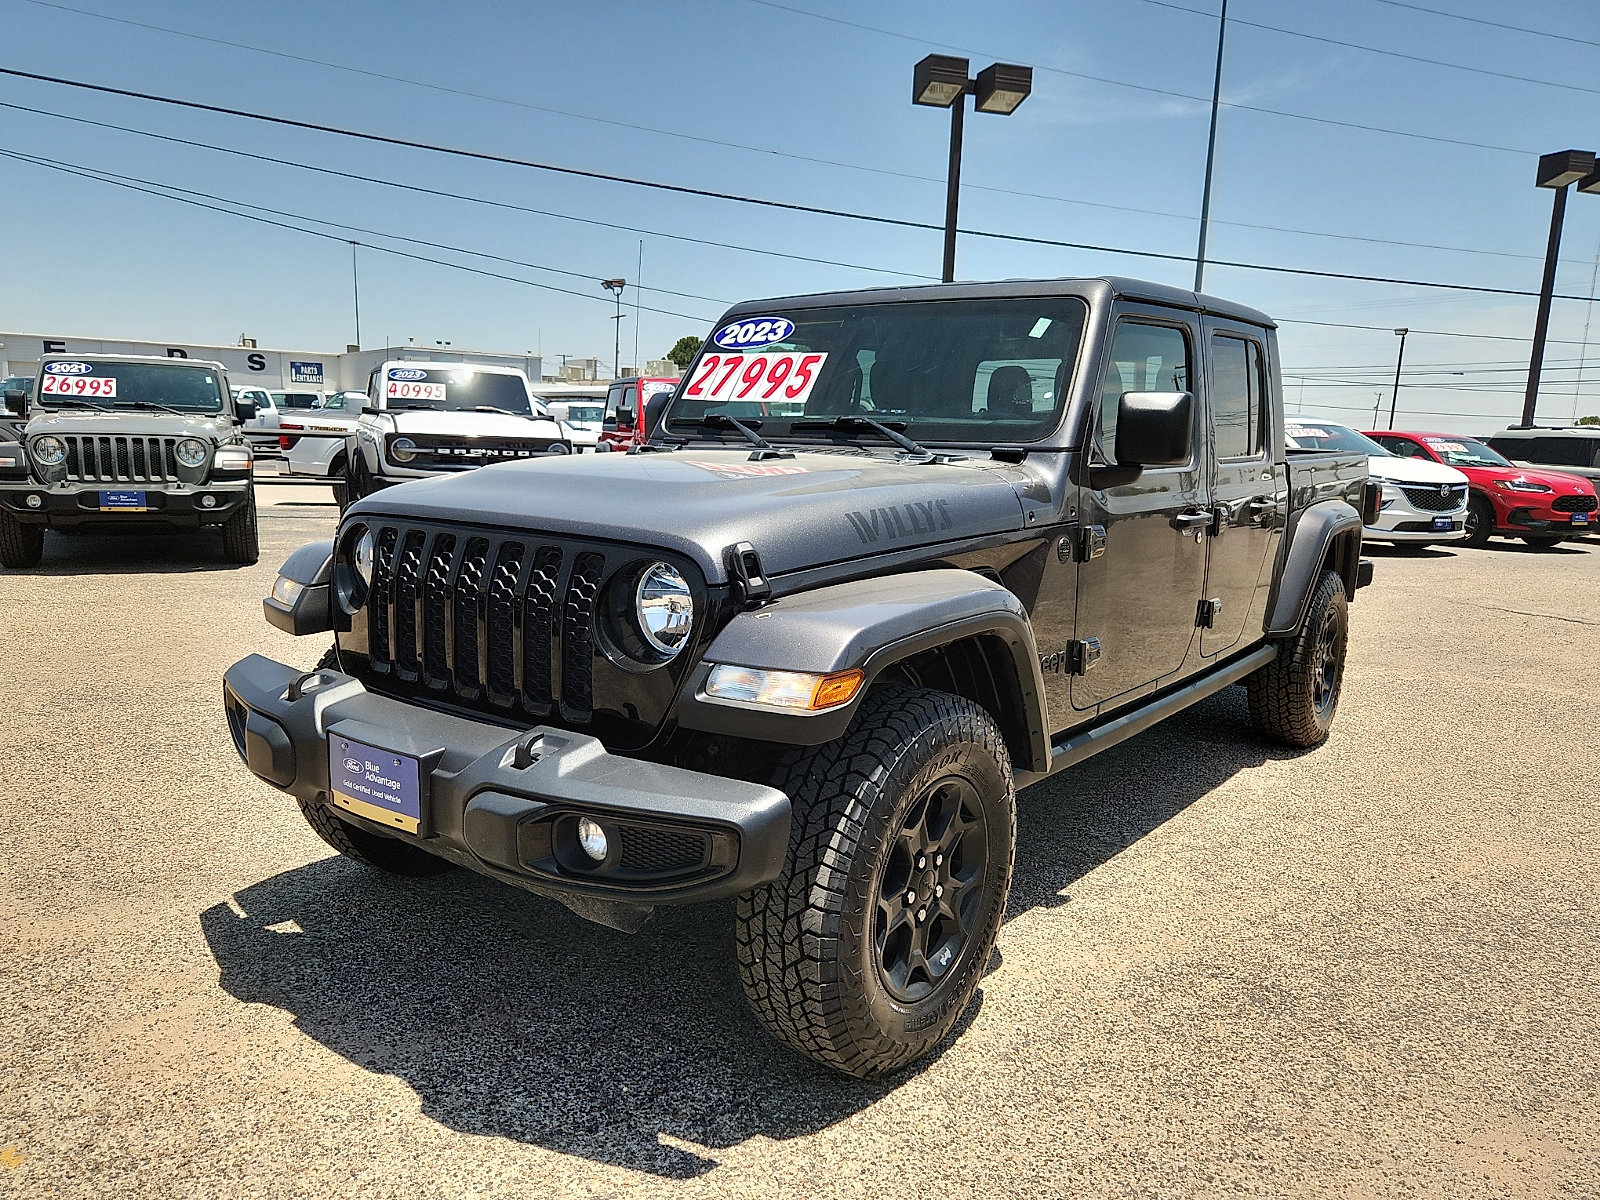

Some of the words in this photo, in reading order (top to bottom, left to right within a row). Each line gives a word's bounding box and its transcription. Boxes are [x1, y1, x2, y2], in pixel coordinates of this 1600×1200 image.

[719, 320, 789, 345] 2023
[51, 363, 86, 374] 2021
[301, 366, 318, 375] PARTS
[686, 354, 823, 399] 27995
[43, 375, 114, 396] 26995
[296, 373, 323, 383] ENTRANCE
[388, 382, 443, 398] 40995
[437, 448, 530, 457] BRONCO
[844, 499, 952, 544] WILLYS
[365, 760, 380, 773] Blue
[365, 771, 401, 790] Advantage
[343, 779, 353, 789] Gold
[353, 783, 371, 795] Certified
[371, 789, 384, 799] Used
[384, 792, 402, 804] Vehicle
